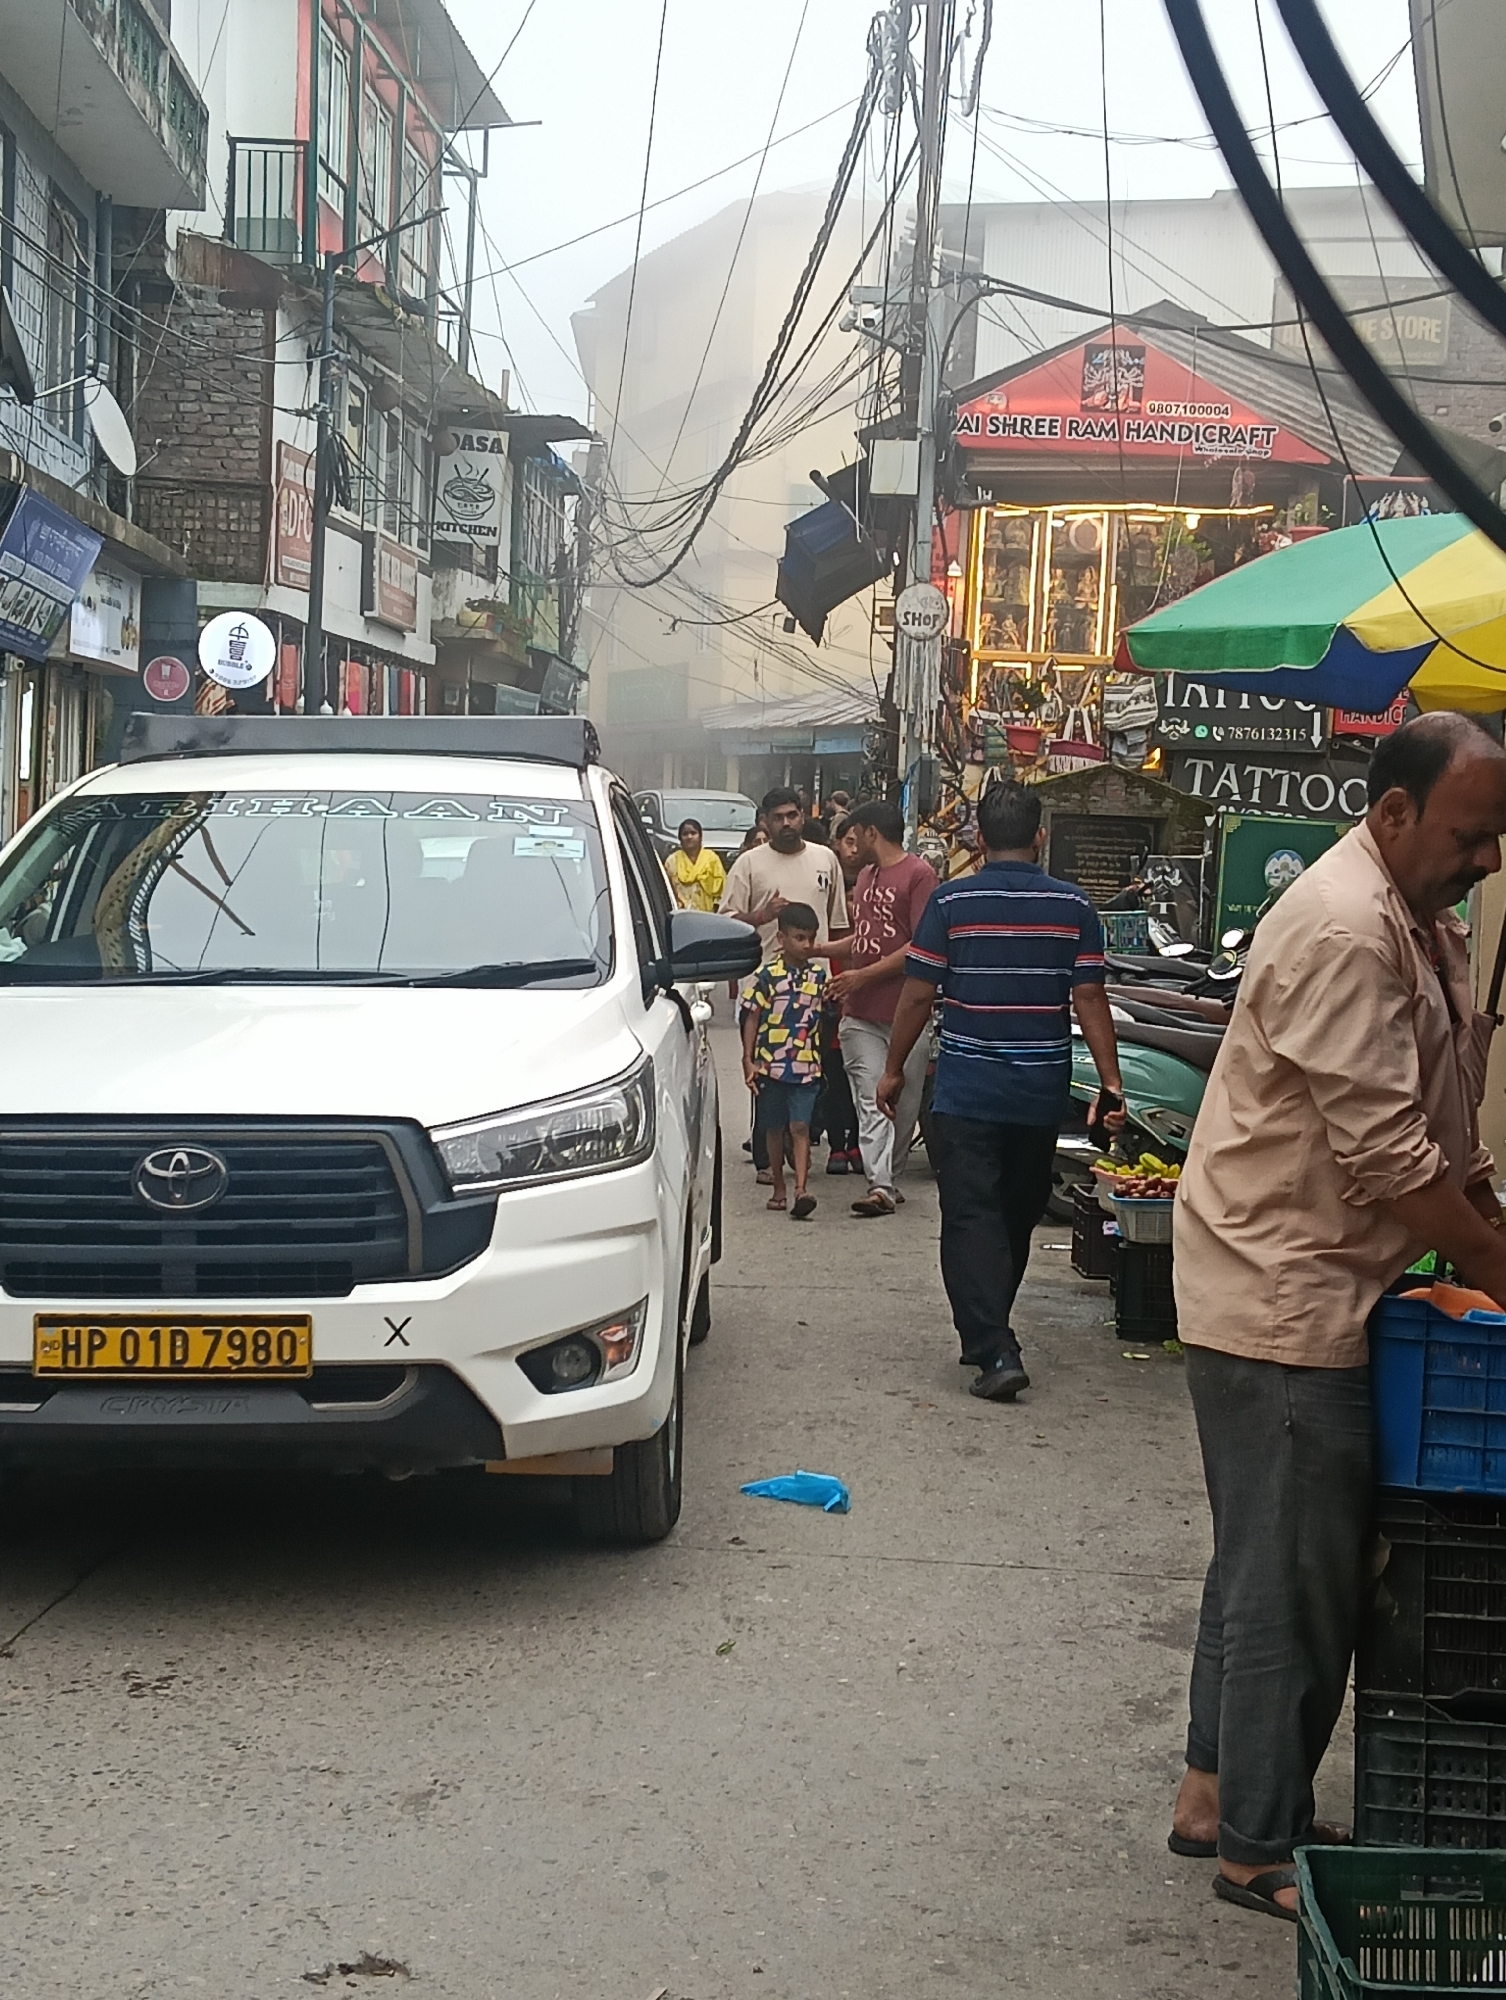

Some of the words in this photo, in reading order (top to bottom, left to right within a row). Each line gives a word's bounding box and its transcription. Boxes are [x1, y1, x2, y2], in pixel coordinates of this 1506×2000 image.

[1380, 316, 1442, 344] STORE
[957, 413, 980, 433] AI
[988, 415, 1060, 437] SHREE
[1068, 419, 1116, 440] RAM
[1126, 420, 1277, 447] HANDICRAFT
[436, 521, 498, 538] KITCHEN
[902, 610, 941, 630] SHOP
[1228, 726, 1307, 741] 7876132315
[62, 1328, 107, 1367] HP
[201, 1328, 298, 1367] 7980
[100, 1394, 251, 1415] CRYSTA
